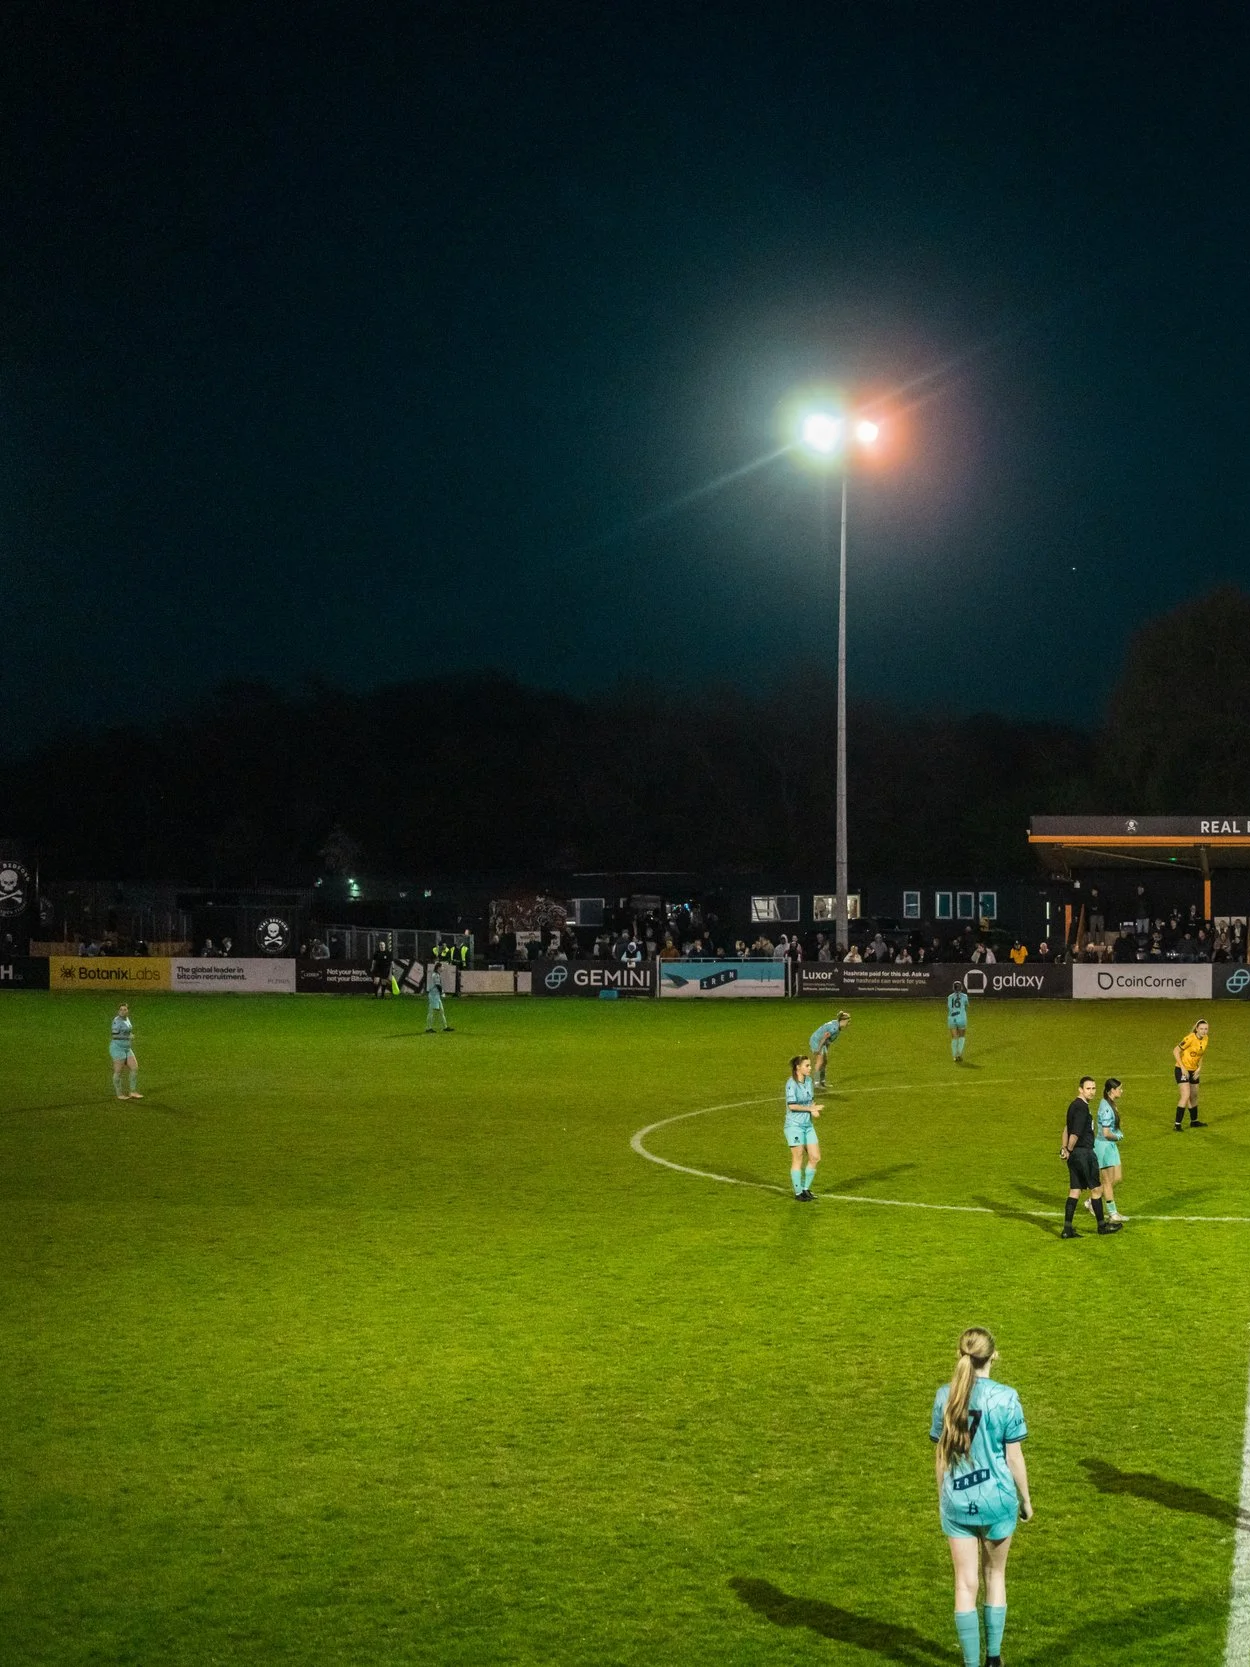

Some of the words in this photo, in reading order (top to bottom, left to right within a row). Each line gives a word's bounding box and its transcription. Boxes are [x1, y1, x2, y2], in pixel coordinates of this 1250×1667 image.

[1200, 820, 1241, 834] REAL
[78, 966, 160, 980] BotanixLabs
[191, 967, 212, 975] global
[574, 969, 650, 986] GEMINI
[802, 969, 833, 980] Luxor
[869, 970, 881, 978] paid
[702, 970, 735, 989] IREN
[992, 972, 1045, 990] galaxy
[1116, 975, 1187, 988] CoinCorner
[951, 997, 961, 1008] 16
[955, 1471, 988, 1490] IREN
